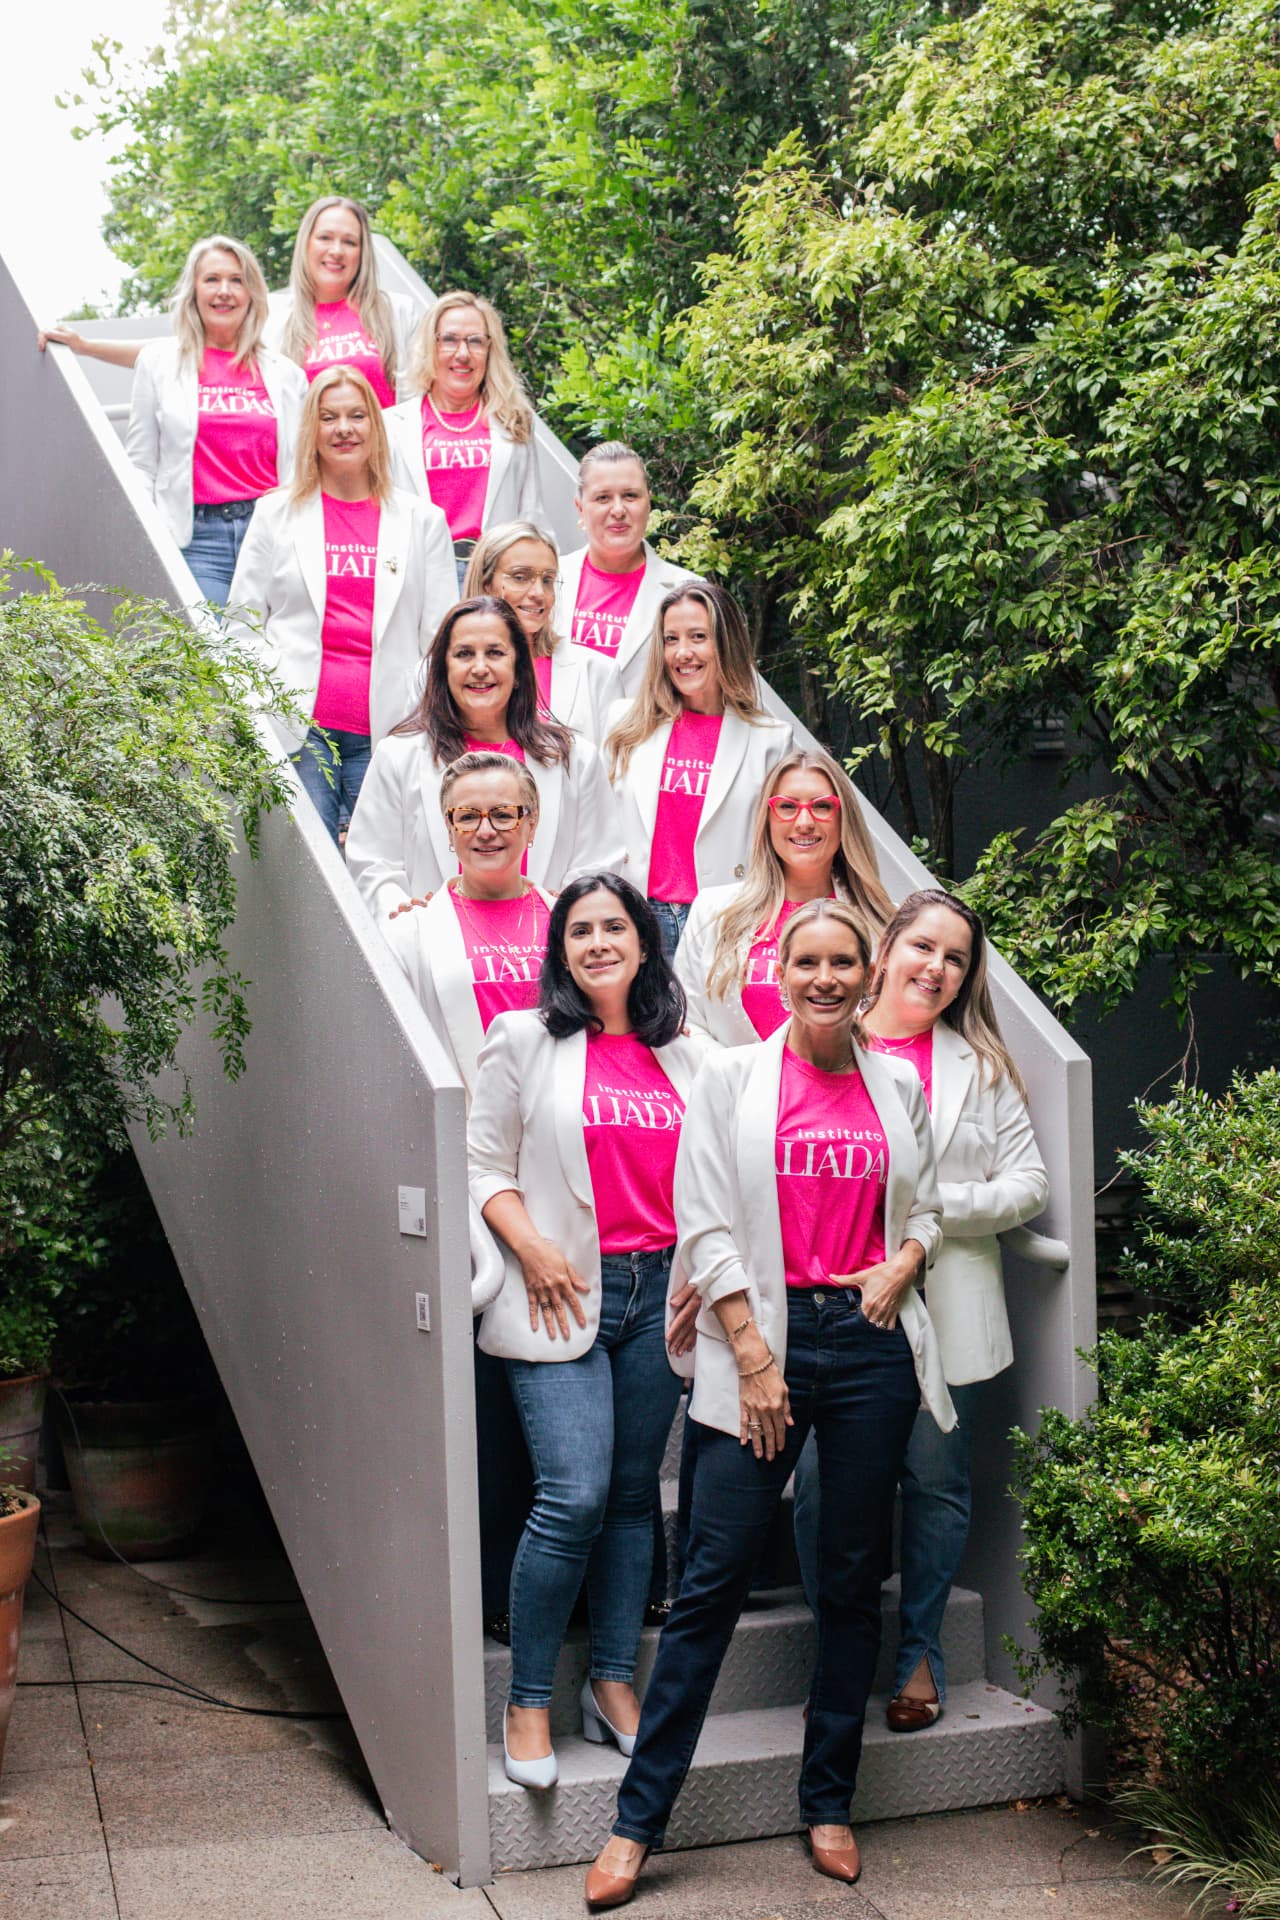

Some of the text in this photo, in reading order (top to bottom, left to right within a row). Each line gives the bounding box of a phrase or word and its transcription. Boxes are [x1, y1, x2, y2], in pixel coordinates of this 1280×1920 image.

[426, 446, 489, 470] LIAD
[326, 542, 377, 554] institu
[667, 757, 714, 770] nstitu
[467, 955, 544, 983] LIAD
[597, 1082, 671, 1100] instituto
[583, 1095, 685, 1131] LIADA
[797, 1128, 882, 1142] instituto
[776, 1141, 886, 1184] LIADA
